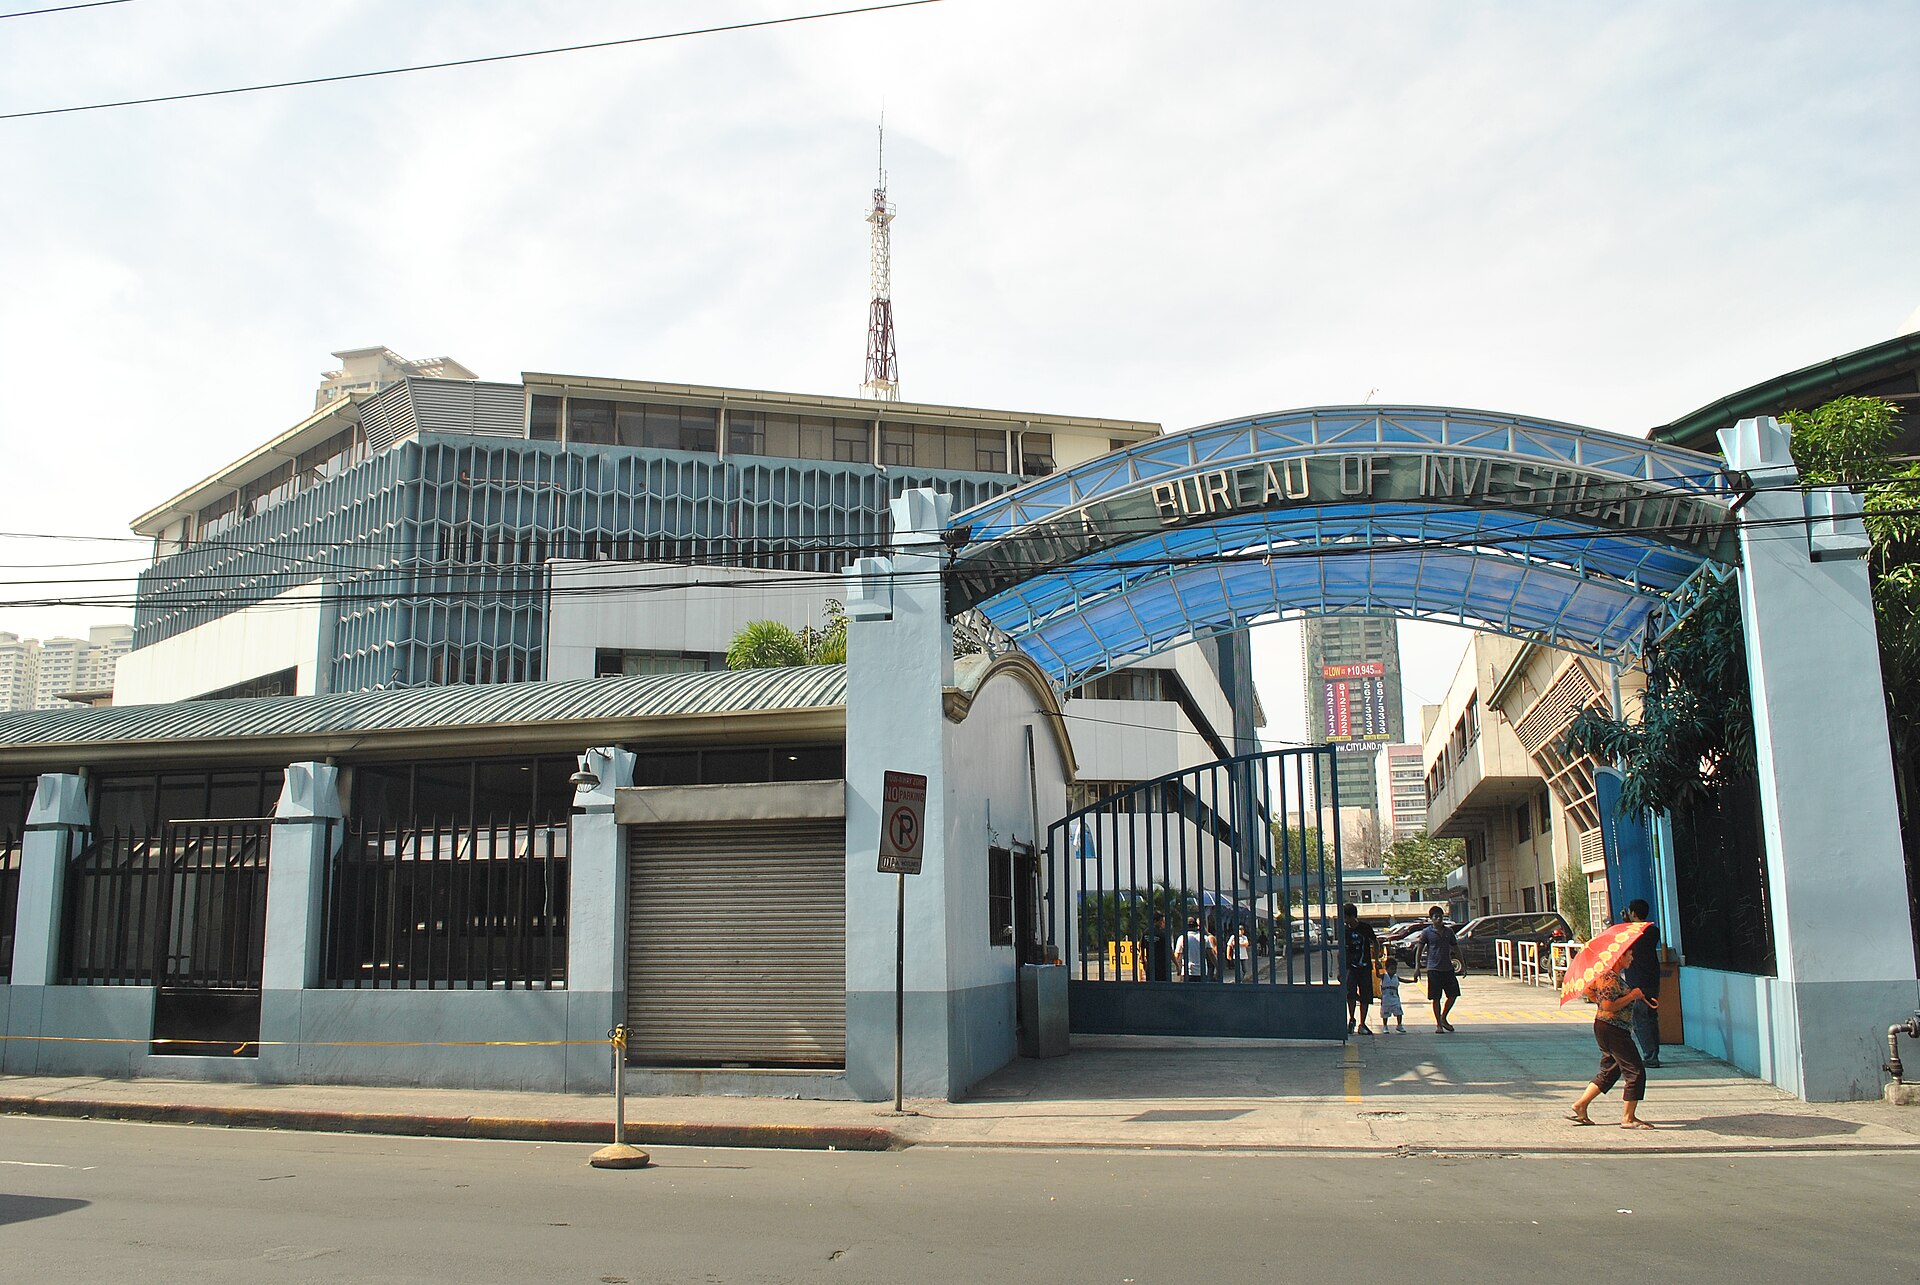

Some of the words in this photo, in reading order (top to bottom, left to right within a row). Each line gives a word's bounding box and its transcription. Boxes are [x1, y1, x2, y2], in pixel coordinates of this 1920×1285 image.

[957, 501, 1135, 600] NATIONAL
[1151, 457, 1310, 525] BUREAU
[1339, 454, 1390, 496] OF
[1419, 455, 1728, 550] INVESTIGATION
[1328, 667, 1340, 677] LOW
[1326, 683, 1336, 736] 242-1212
[1339, 683, 1348, 736] 812-2222
[885, 786, 898, 801] NO
[899, 790, 925, 802] PARKING
